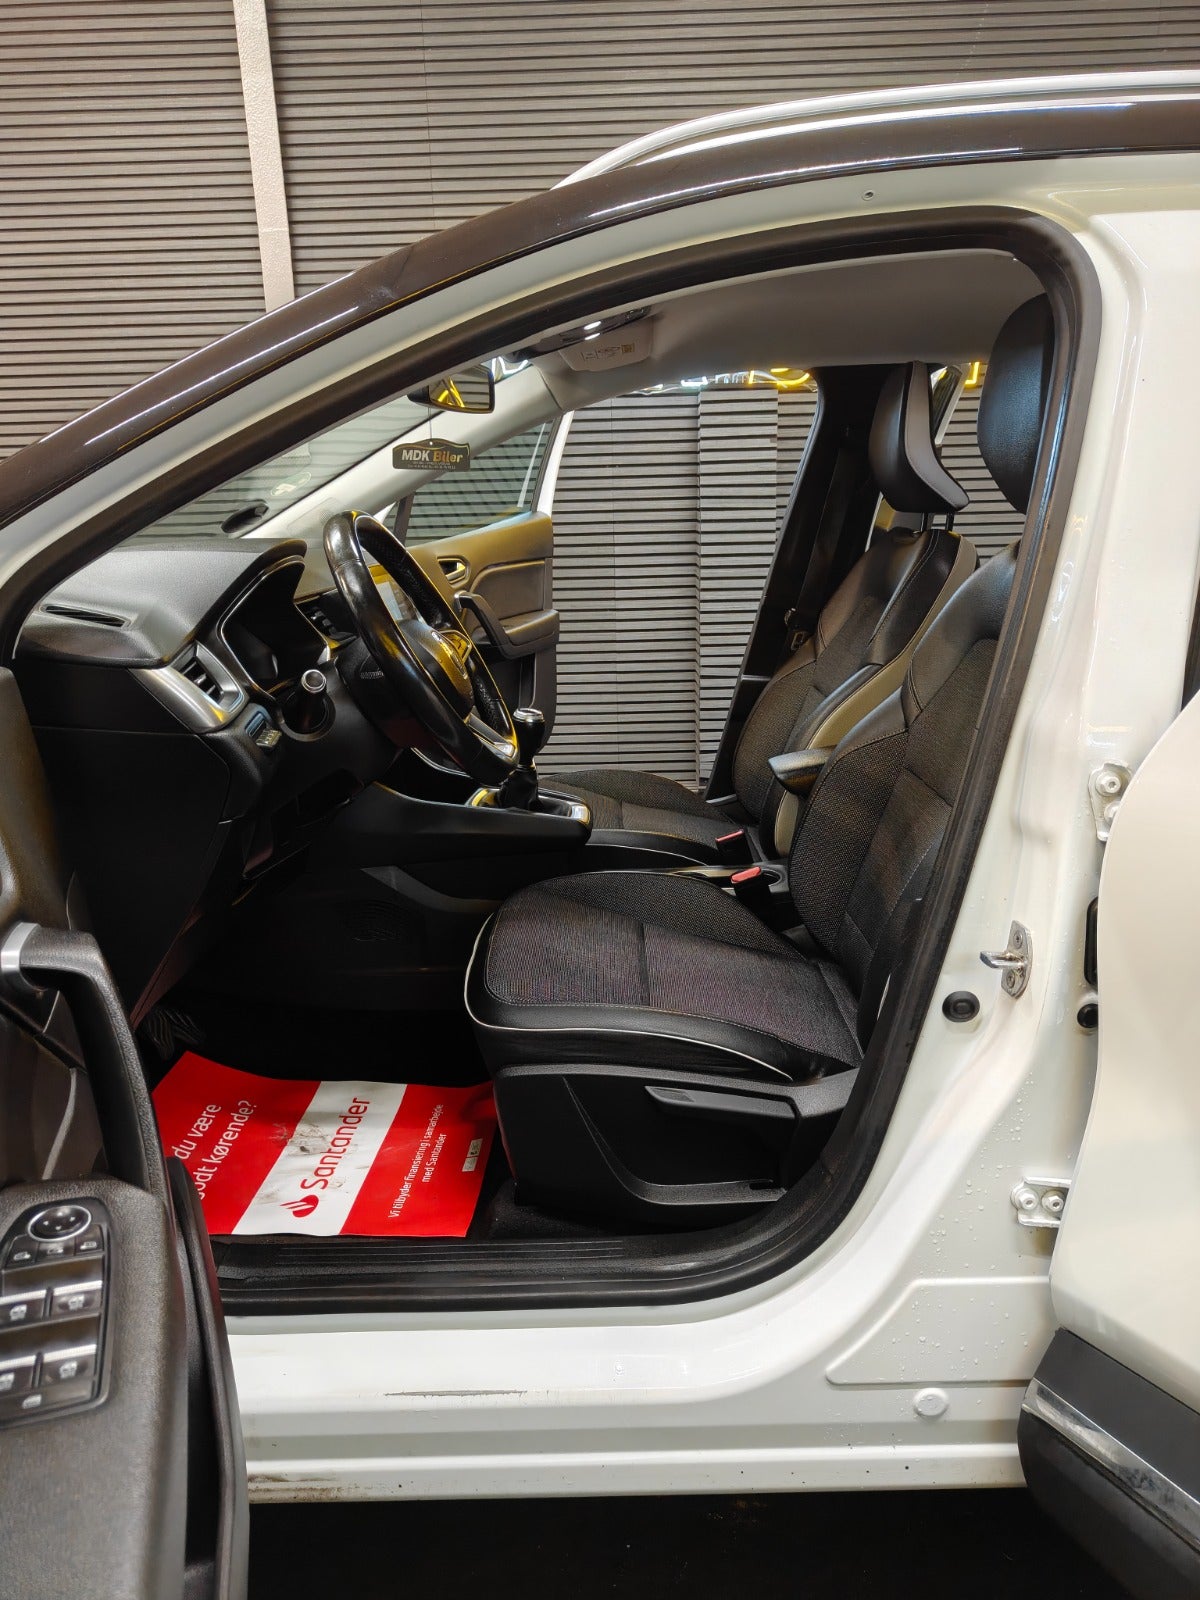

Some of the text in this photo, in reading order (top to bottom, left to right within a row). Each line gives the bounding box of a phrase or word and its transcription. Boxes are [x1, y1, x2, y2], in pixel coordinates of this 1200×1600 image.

[402, 449, 463, 463] MDK Biler
[171, 1104, 222, 1160] du være
[424, 1104, 444, 1139] samarbejde
[193, 1100, 257, 1200] odt kørende?
[300, 1097, 371, 1189] Santander
[404, 1142, 431, 1181] finansiering
[422, 1133, 447, 1183] med Santander
[388, 1209, 400, 1218] Vi
[392, 1182, 412, 1209] tilbyder
